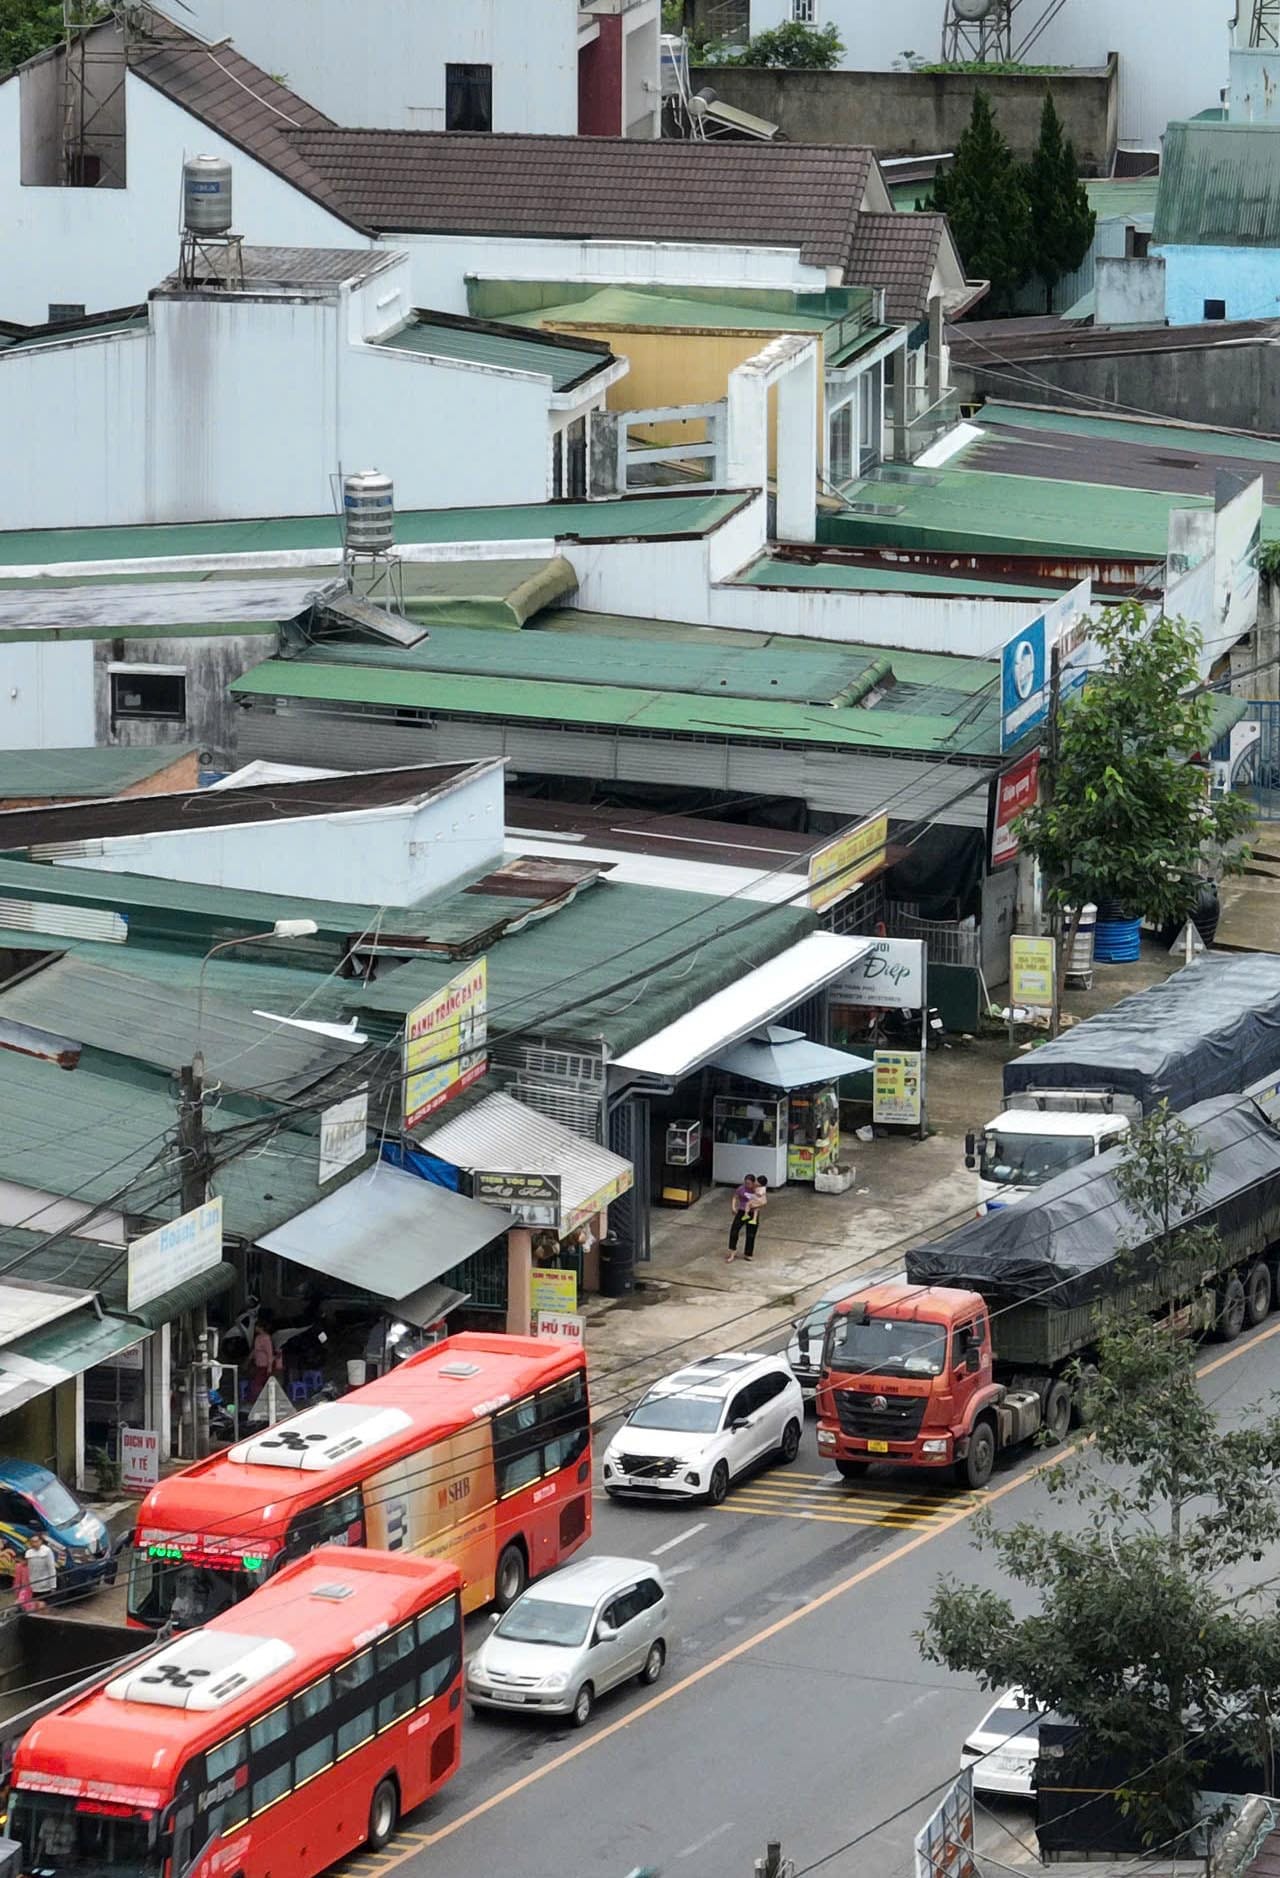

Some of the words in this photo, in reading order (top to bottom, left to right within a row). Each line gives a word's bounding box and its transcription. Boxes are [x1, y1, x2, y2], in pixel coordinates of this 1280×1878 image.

[131, 1457, 136, 1469] Y
[139, 1455, 149, 1471] TẾ
[449, 1476, 470, 1501] SHB
